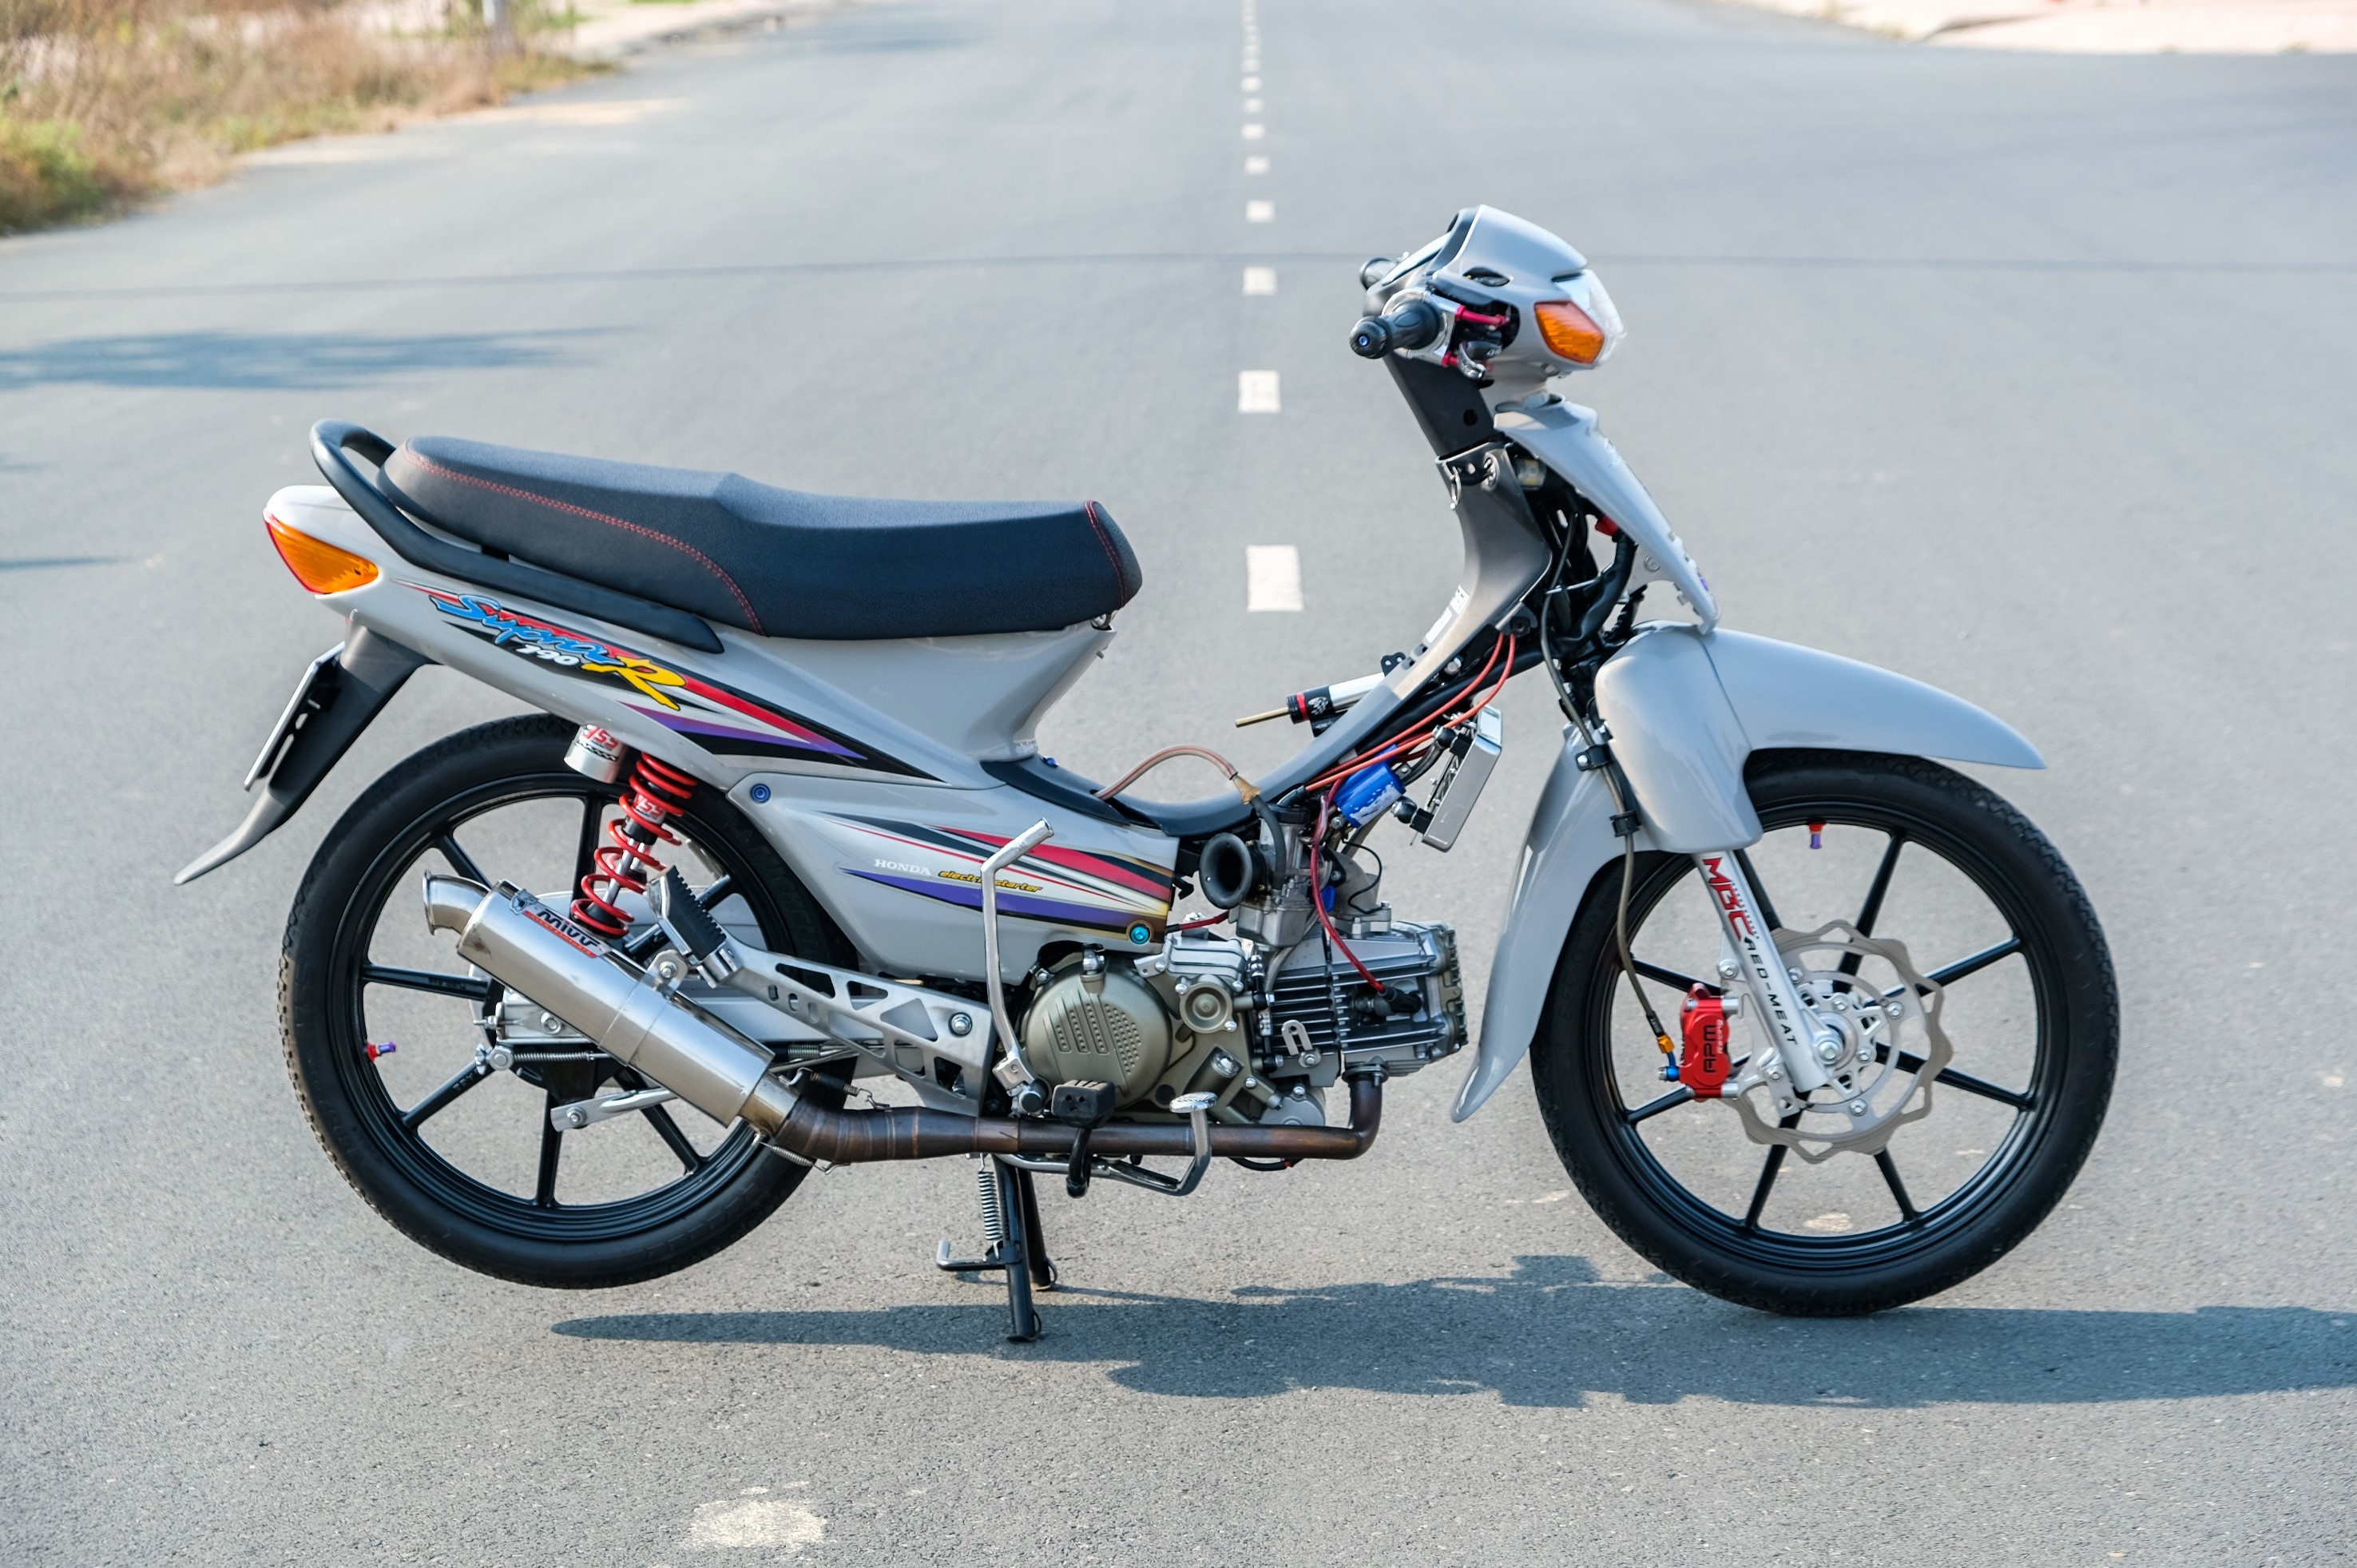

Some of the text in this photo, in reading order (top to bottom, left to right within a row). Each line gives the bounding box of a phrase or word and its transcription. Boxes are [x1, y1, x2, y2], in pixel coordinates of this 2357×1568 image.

[429, 594, 687, 711] Supra R
[873, 859, 932, 876] HONDA
[994, 878, 1043, 892] starter
[1703, 1024, 1717, 1073] APM
